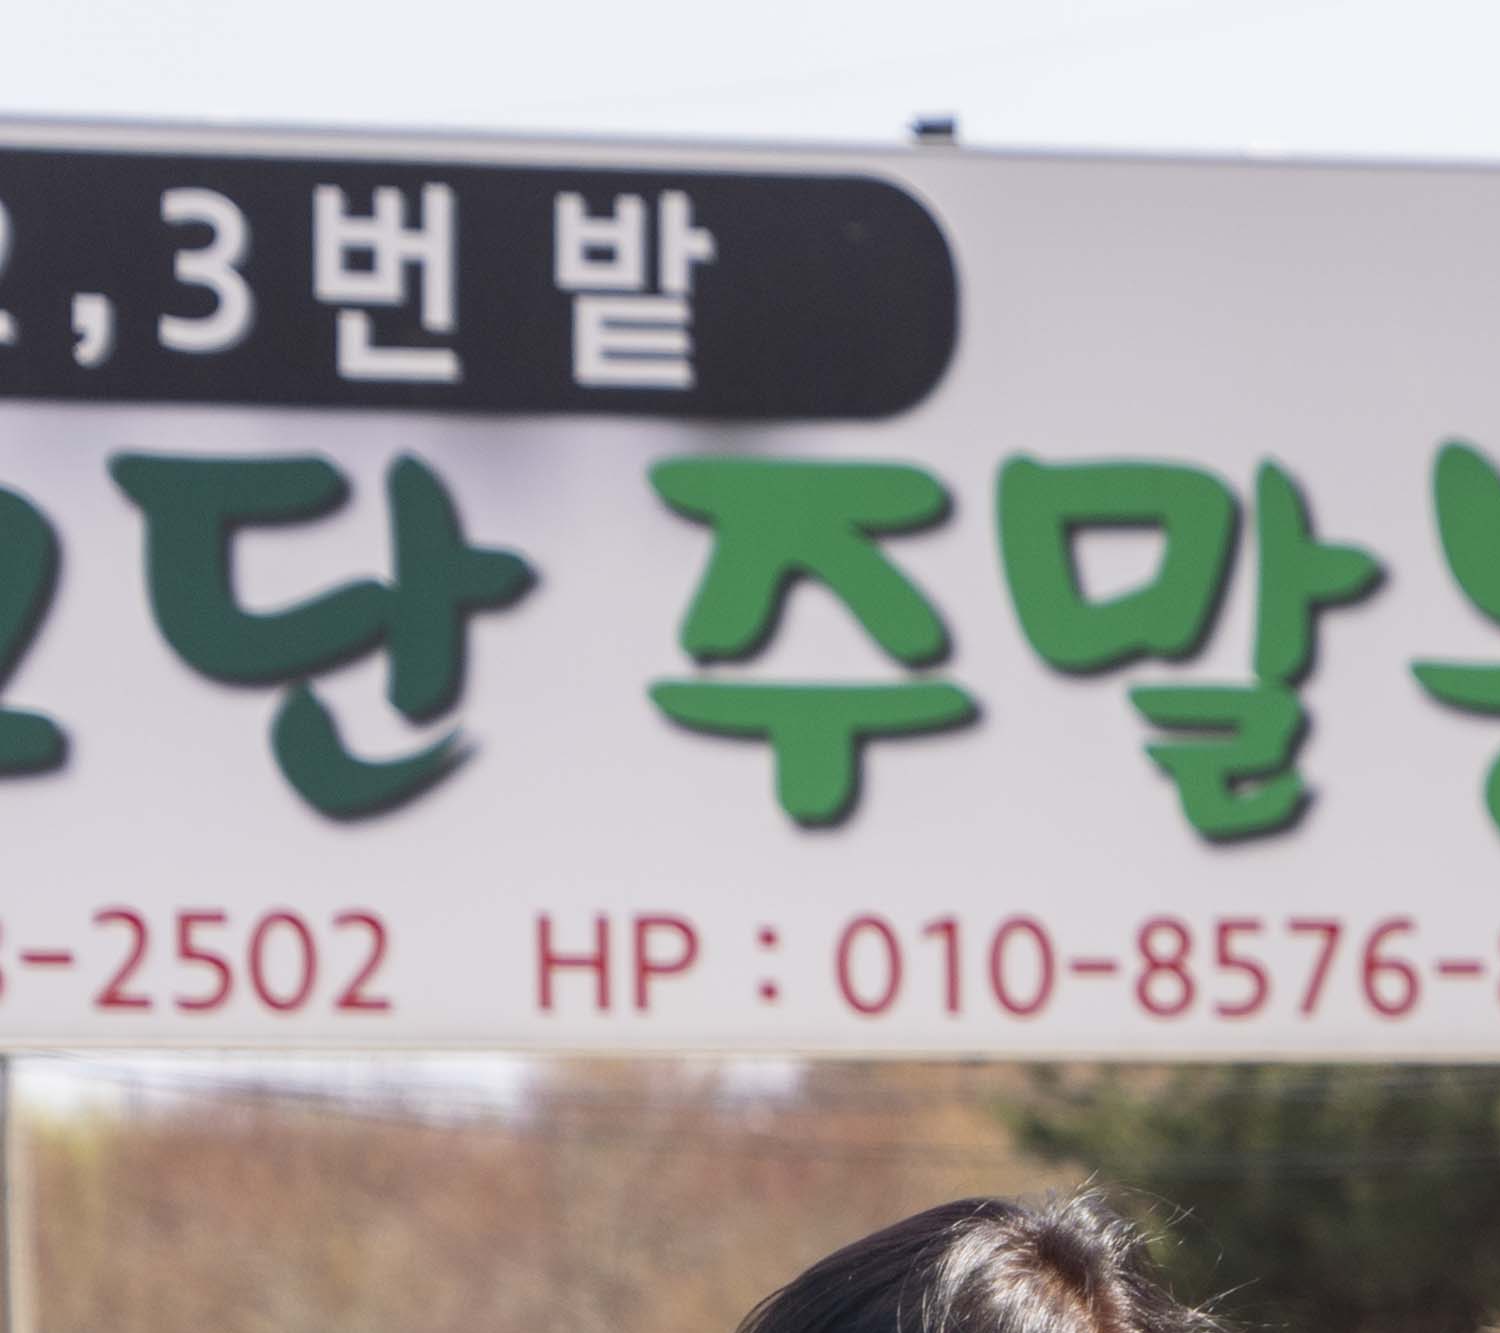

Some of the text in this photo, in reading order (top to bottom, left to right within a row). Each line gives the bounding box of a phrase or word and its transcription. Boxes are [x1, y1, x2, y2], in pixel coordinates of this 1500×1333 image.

[0, 184, 714, 388] ,3번 밭
[0, 450, 534, 826] 단
[0, 906, 393, 1015] -2502
[535, 913, 702, 1011] HP
